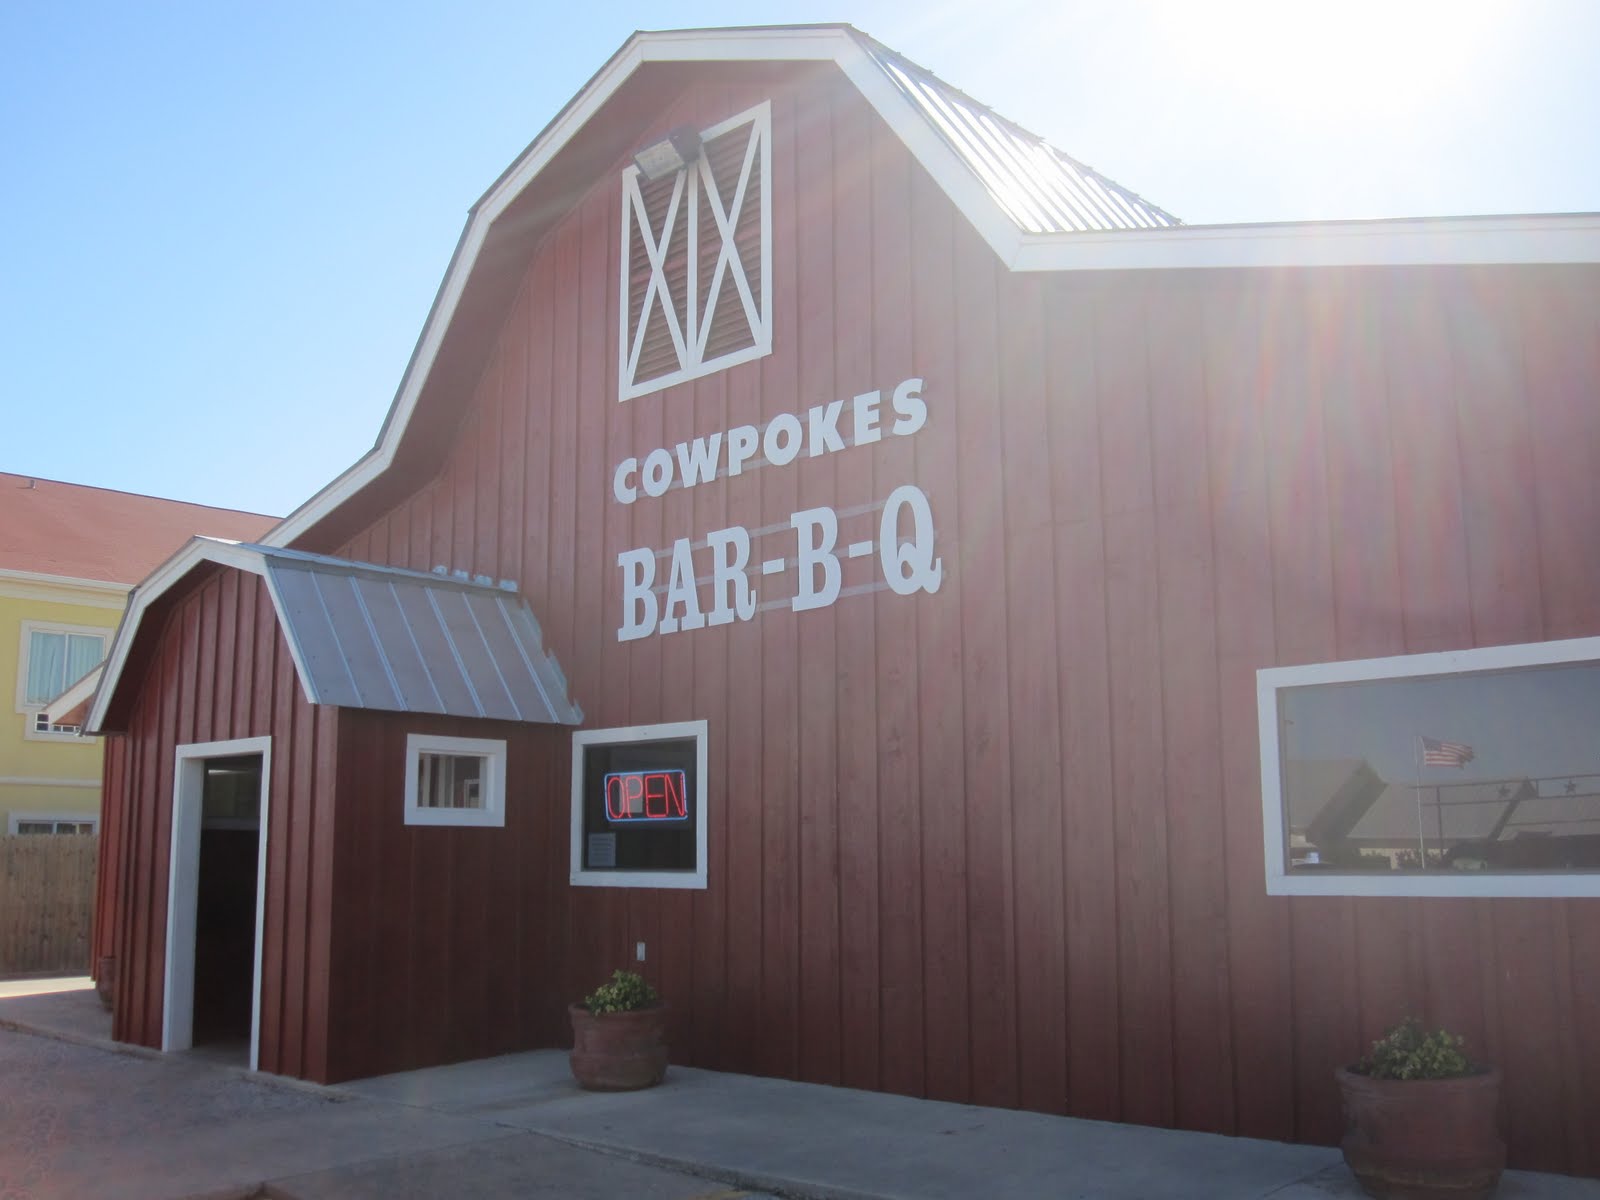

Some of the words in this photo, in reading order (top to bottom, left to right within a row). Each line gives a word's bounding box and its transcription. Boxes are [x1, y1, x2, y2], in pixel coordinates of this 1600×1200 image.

[613, 378, 927, 504] COWPOKES
[617, 485, 942, 641] BAR-B-Q
[607, 774, 685, 818] OPEN
